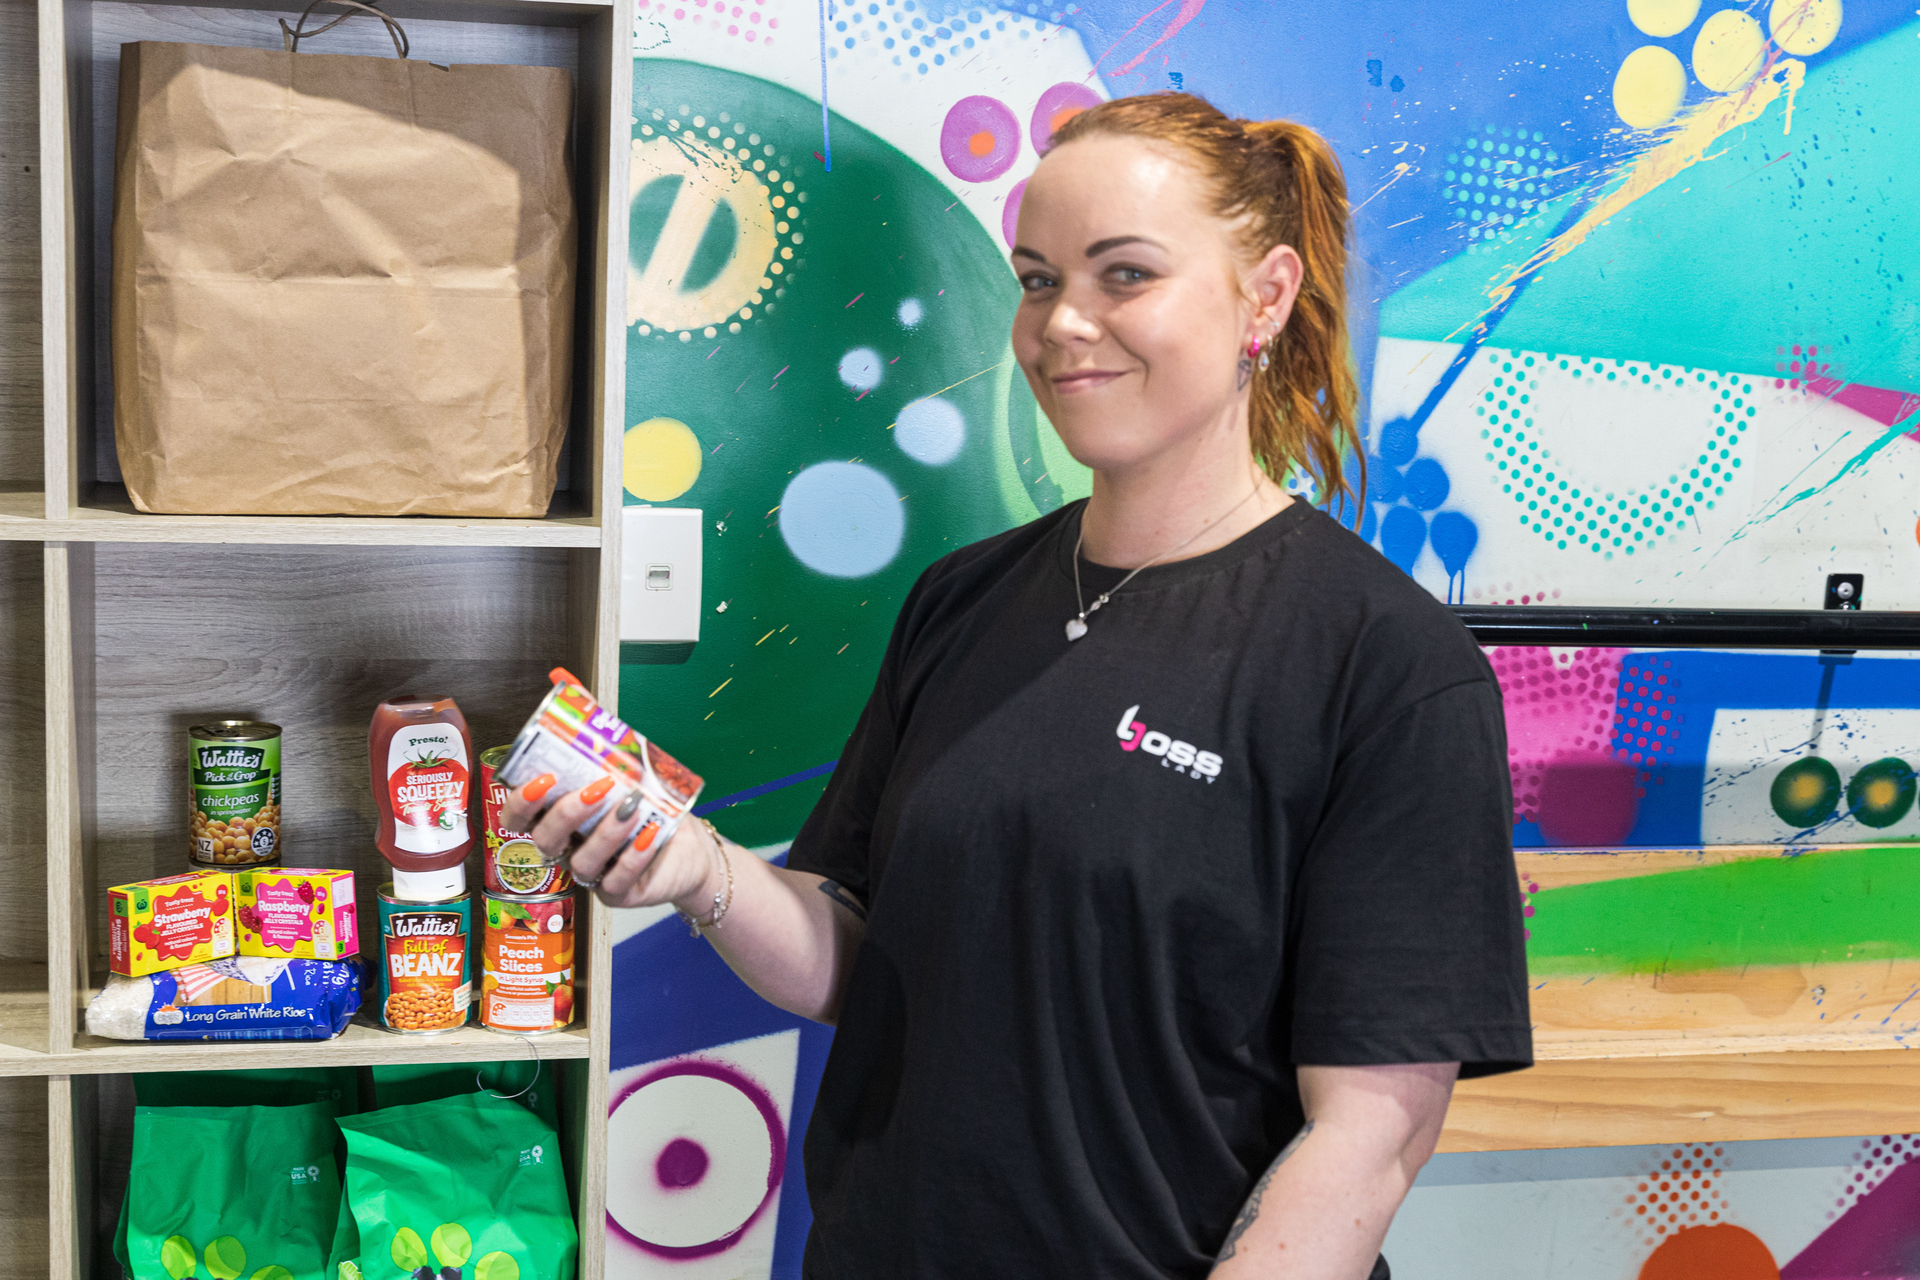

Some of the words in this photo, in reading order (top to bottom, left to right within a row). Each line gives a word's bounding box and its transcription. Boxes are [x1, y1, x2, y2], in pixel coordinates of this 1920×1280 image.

[201, 749, 260, 768] Wattie's
[204, 771, 226, 782] Pick
[234, 770, 256, 782] Crop
[406, 772, 454, 785] SERIOUSLY
[397, 781, 465, 803] SQUEEZY
[201, 793, 260, 810] chickpeas
[498, 827, 533, 839] CHICK
[258, 900, 310, 916] Raspberry
[153, 907, 211, 927] Strawberry
[395, 918, 457, 937] Wattie's
[403, 939, 431, 956] Full
[431, 939, 450, 956] of
[499, 944, 544, 959] Peach
[390, 952, 462, 978] BEANZ
[499, 958, 543, 972] Slices
[331, 963, 350, 985] ong
[505, 975, 522, 984] Light
[524, 976, 544, 985] Syrup
[186, 1010, 214, 1024] Long
[215, 1009, 247, 1021] Grain
[249, 1007, 281, 1019] White
[283, 1006, 306, 1018] Rice
